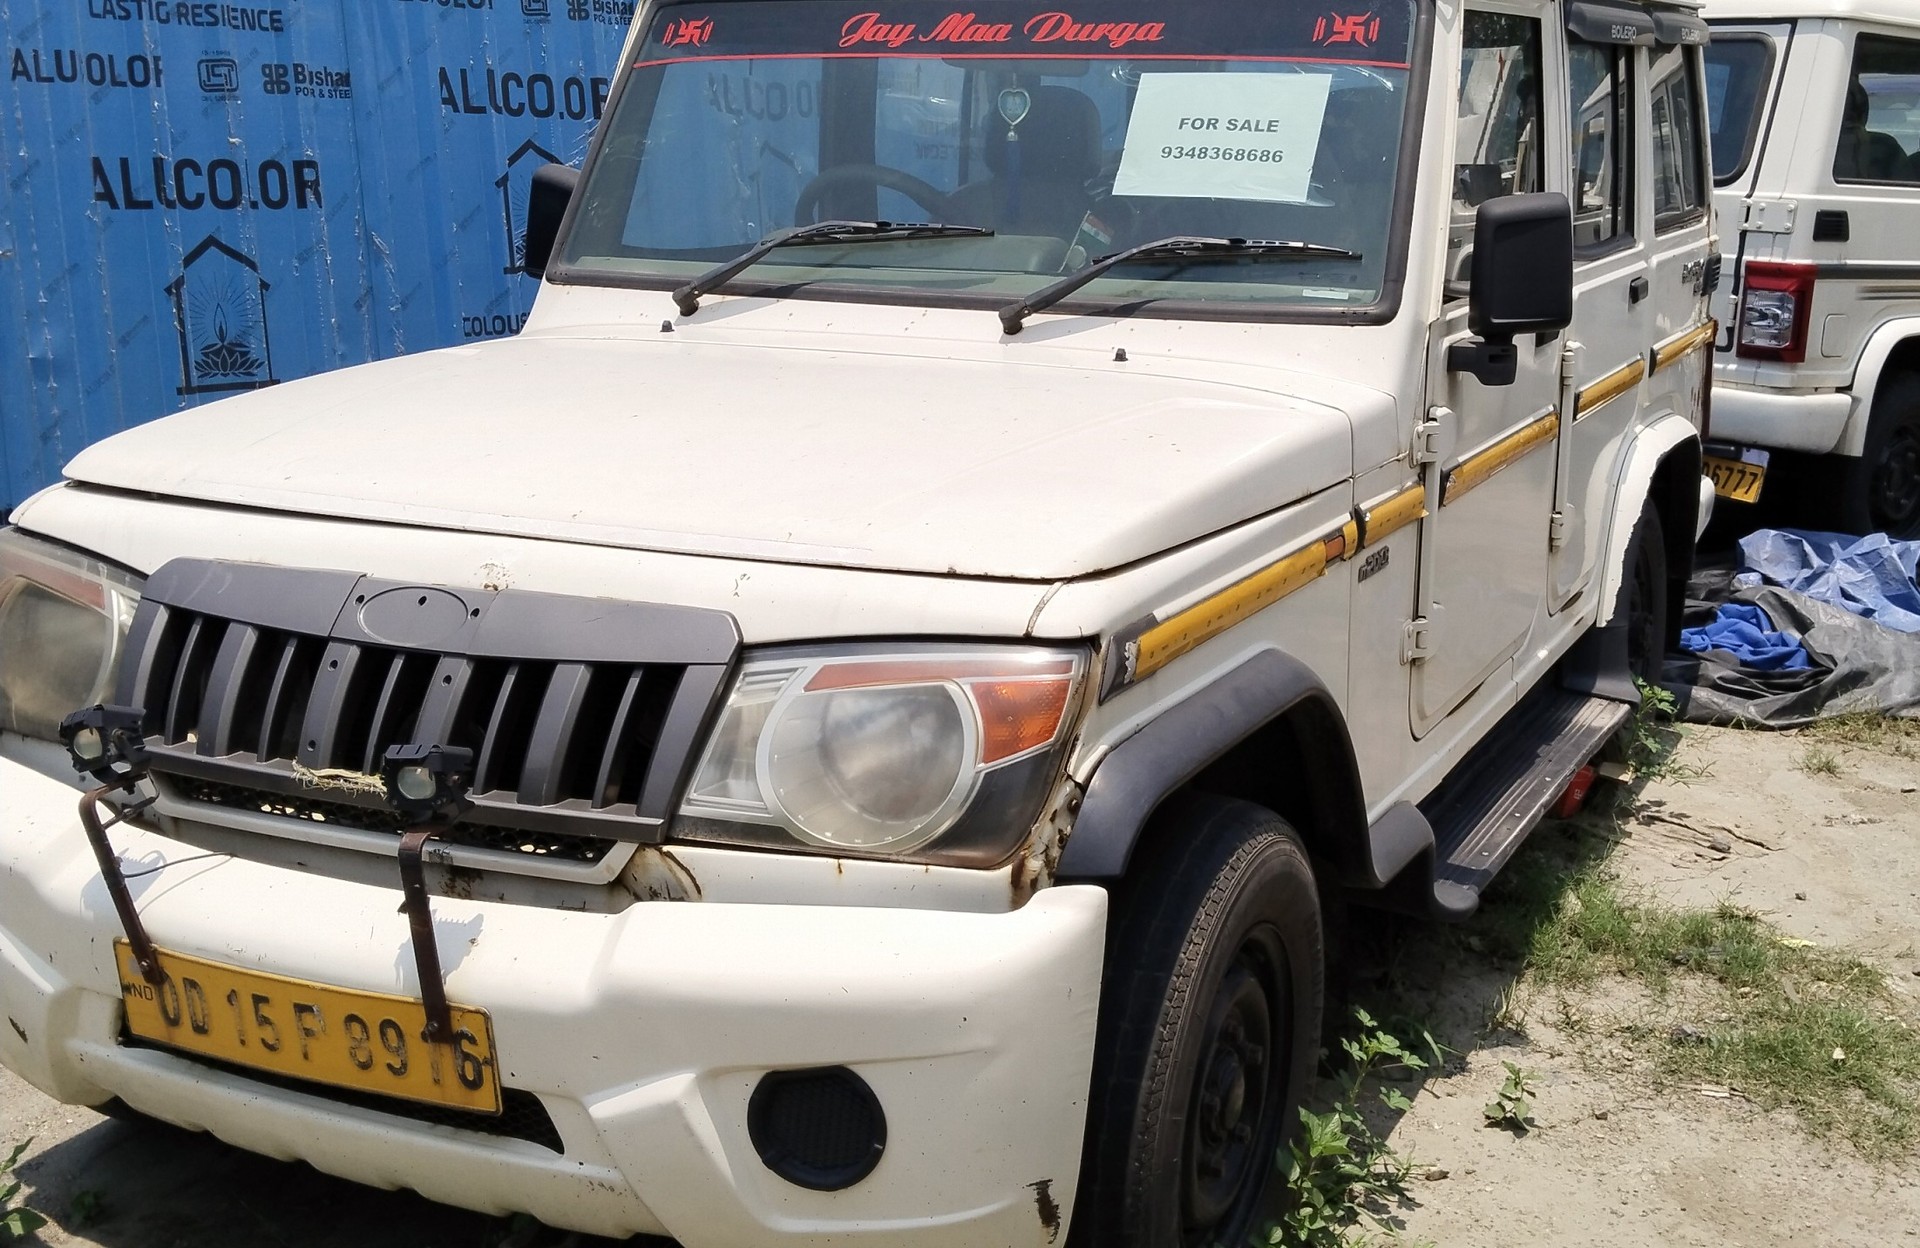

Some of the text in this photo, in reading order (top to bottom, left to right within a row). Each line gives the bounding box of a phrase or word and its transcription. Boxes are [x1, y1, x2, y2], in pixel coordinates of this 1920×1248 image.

[838, 11, 1166, 49] Jay Maa Durga
[1611, 24, 1637, 39] BOLERO
[1178, 117, 1280, 133] FOR SALE
[1160, 146, 1284, 163] 9348368686
[226, 988, 281, 1052] 15
